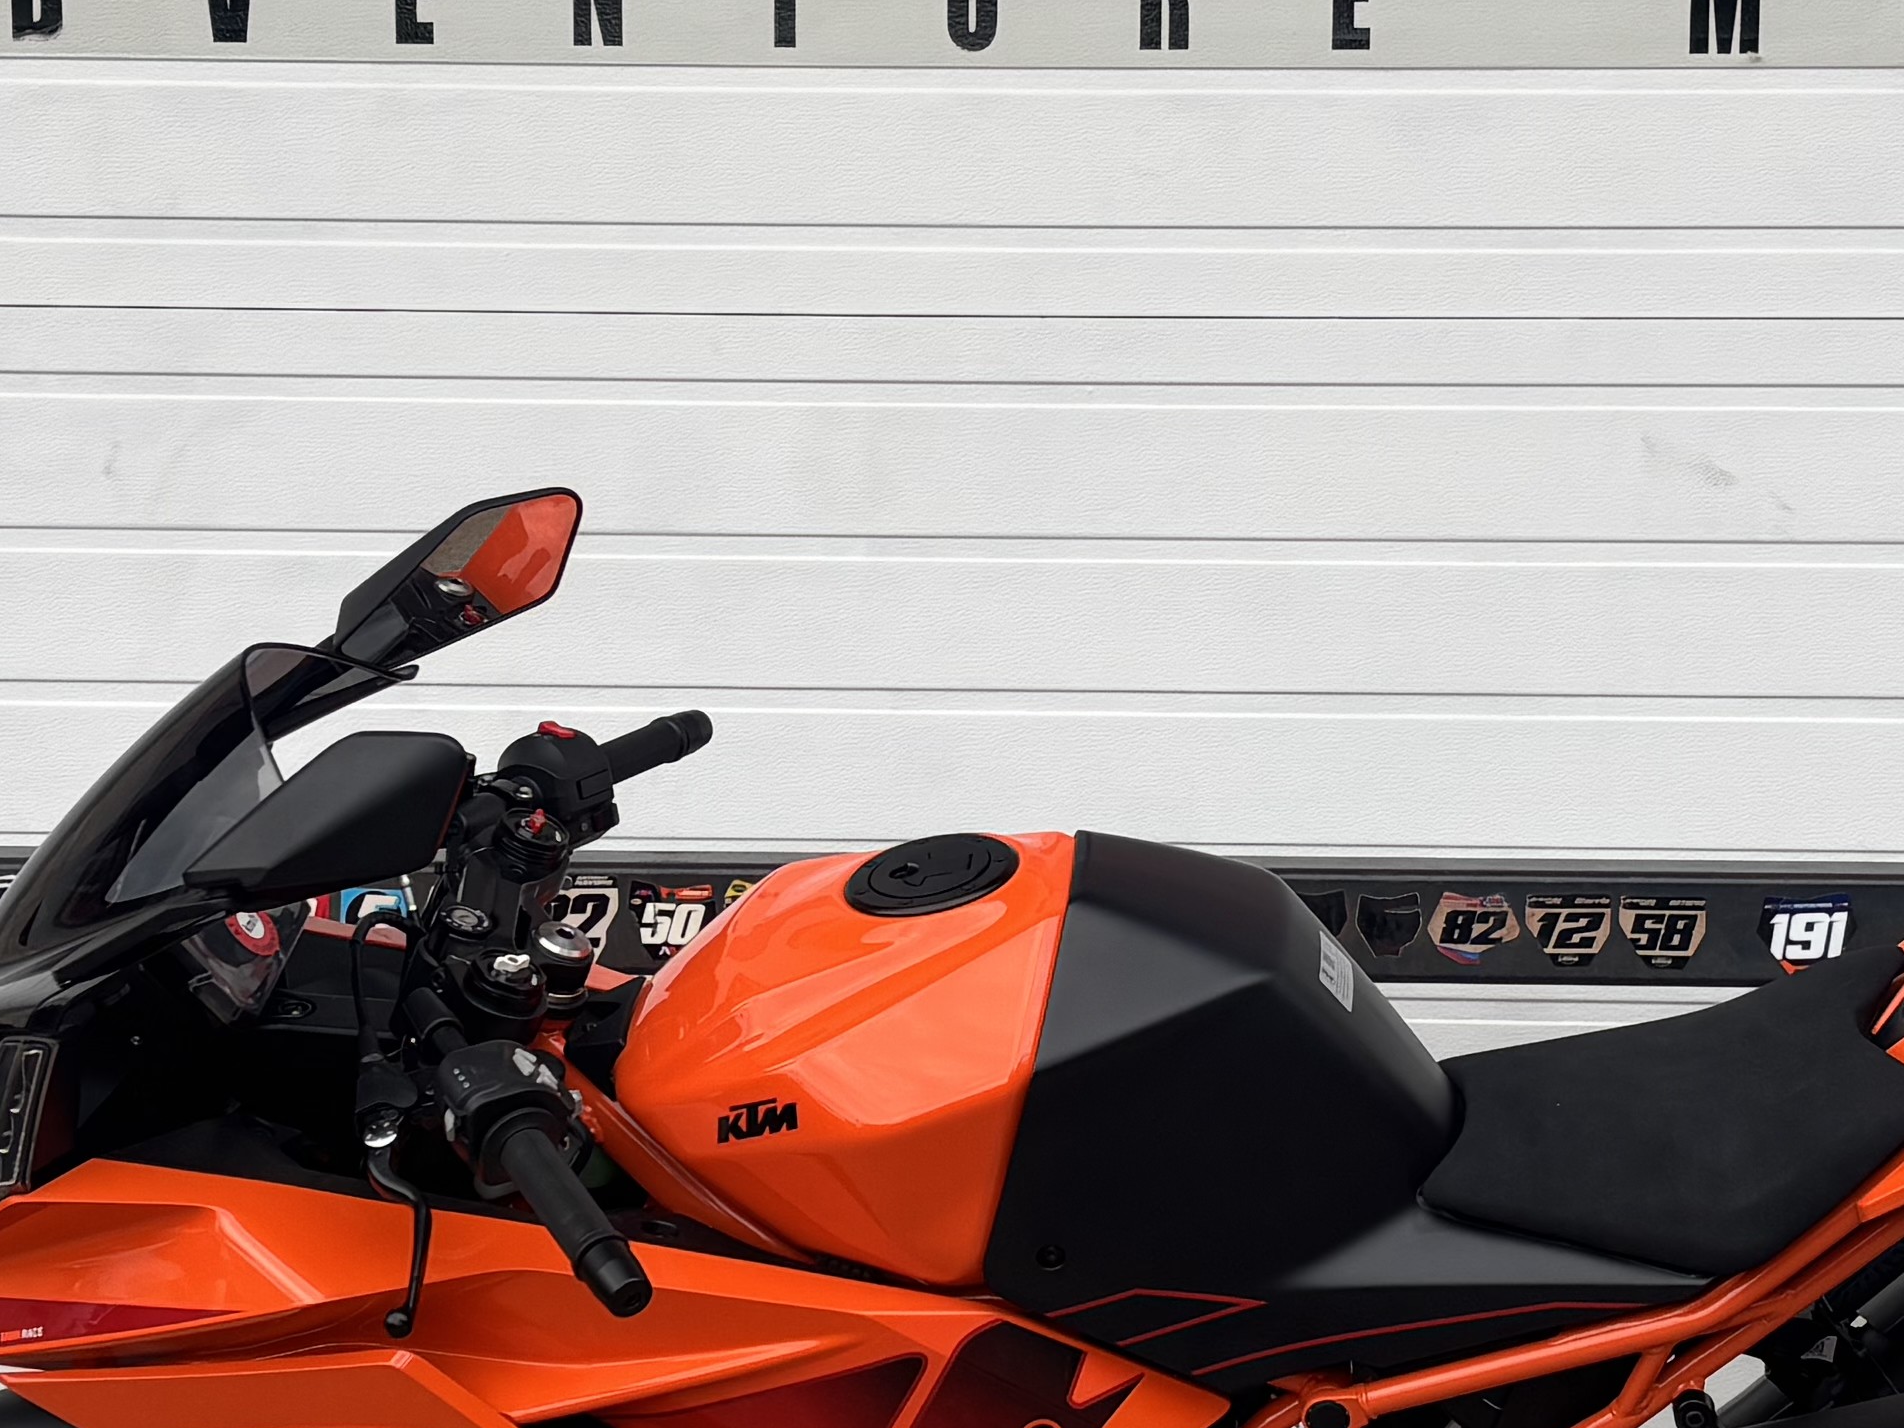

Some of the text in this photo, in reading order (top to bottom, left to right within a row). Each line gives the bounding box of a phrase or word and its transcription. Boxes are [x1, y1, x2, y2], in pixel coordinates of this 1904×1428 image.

[640, 903, 705, 945] 50
[1439, 909, 1509, 945] 82
[1534, 912, 1606, 949] 12
[1628, 913, 1698, 951] 58
[1769, 911, 1848, 960] 191
[717, 1097, 798, 1144] KTM
